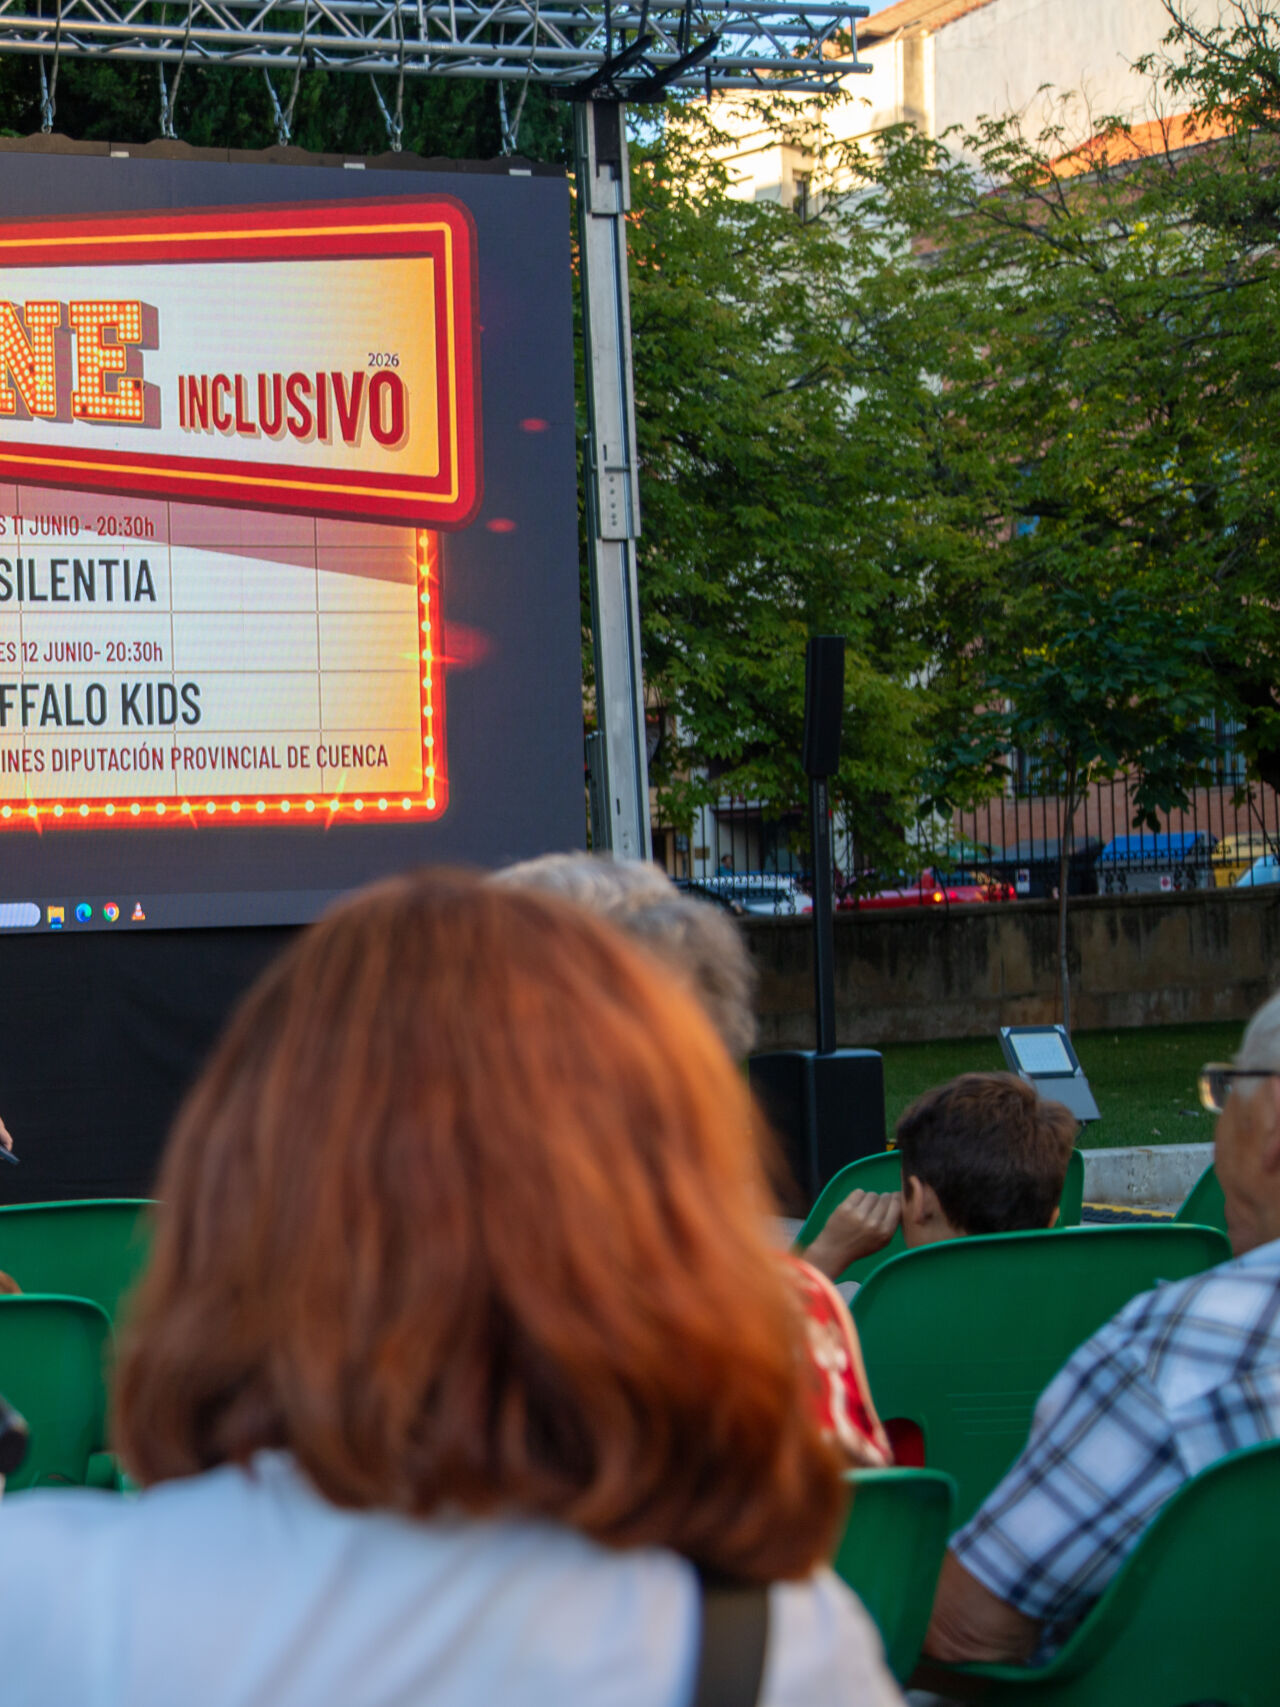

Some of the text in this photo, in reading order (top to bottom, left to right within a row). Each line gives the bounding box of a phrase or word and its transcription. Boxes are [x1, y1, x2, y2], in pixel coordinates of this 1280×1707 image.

[367, 352, 400, 368] 2026
[178, 370, 406, 447] INCLUSIVO
[11, 515, 24, 536] 11
[29, 515, 80, 536] JUNIO
[96, 515, 155, 537] 20:30h
[21, 641, 39, 662] 12
[105, 641, 164, 662] 20:30h
[121, 681, 202, 727] KIDS
[52, 741, 164, 773] DIPUTACIÓN
[170, 745, 282, 771] PROVINCIAL
[287, 745, 311, 769] DE
[316, 744, 389, 769] CUENCA
